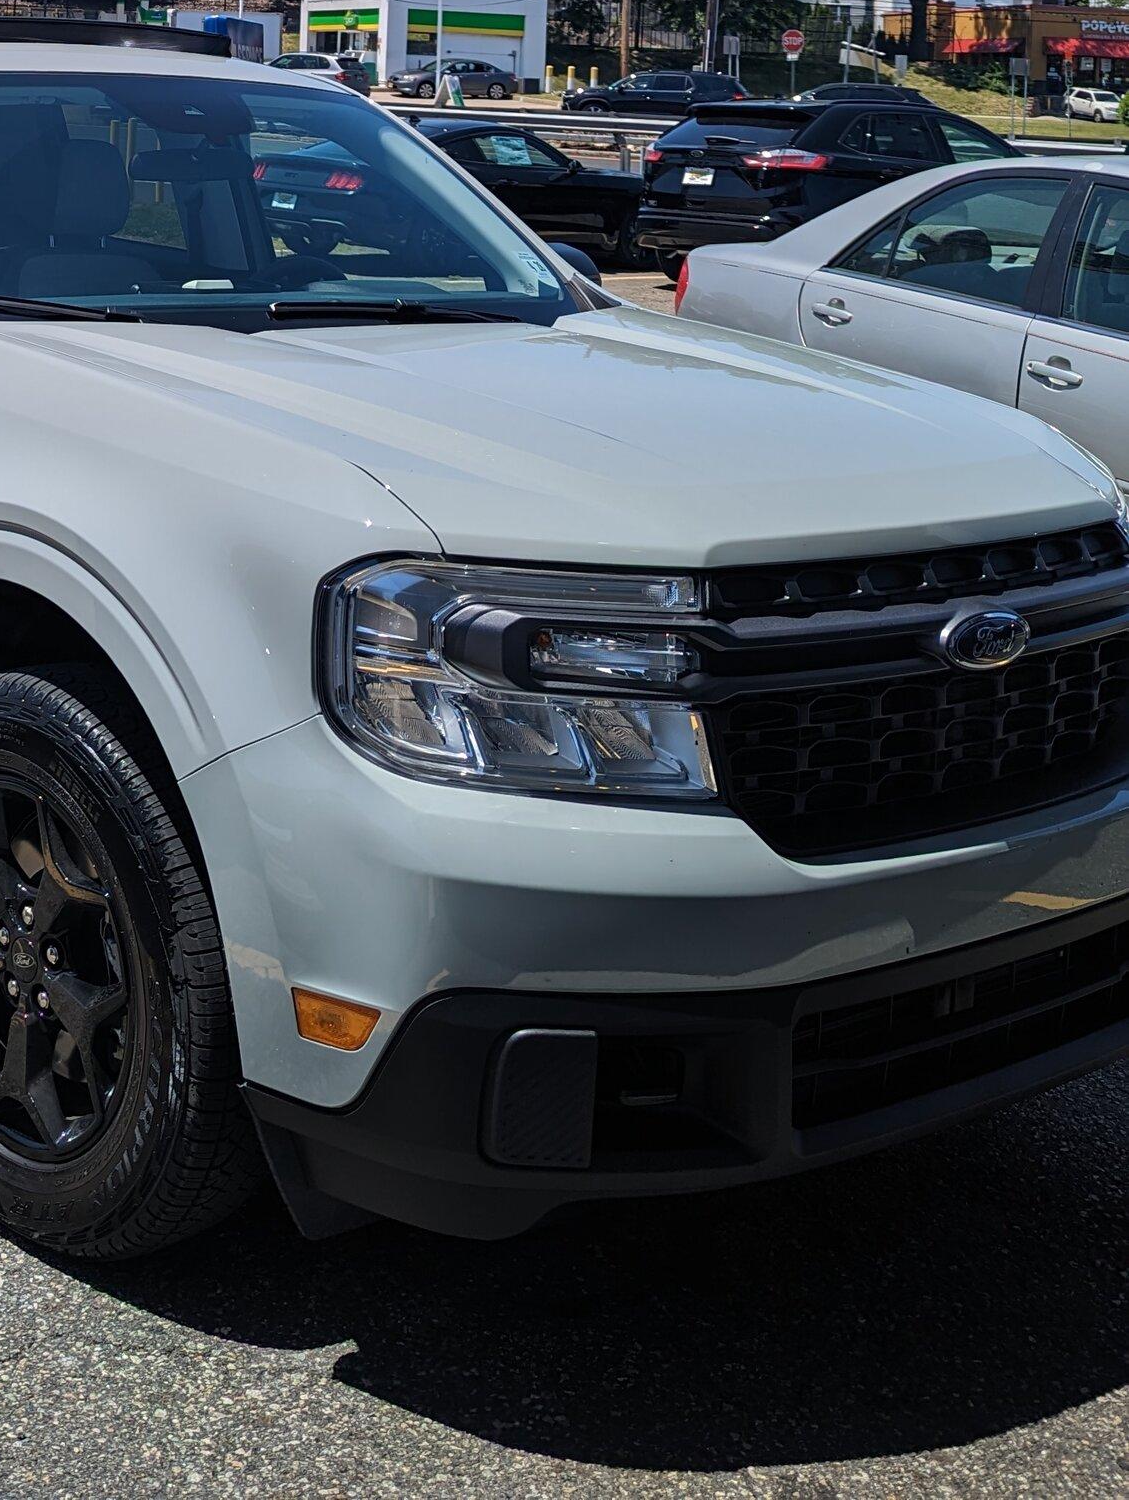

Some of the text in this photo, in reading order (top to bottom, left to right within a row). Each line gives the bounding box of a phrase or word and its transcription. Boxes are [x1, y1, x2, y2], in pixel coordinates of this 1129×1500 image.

[784, 36, 803, 45] STOP
[972, 625, 1015, 658] Ford
[15, 953, 31, 966] Ford
